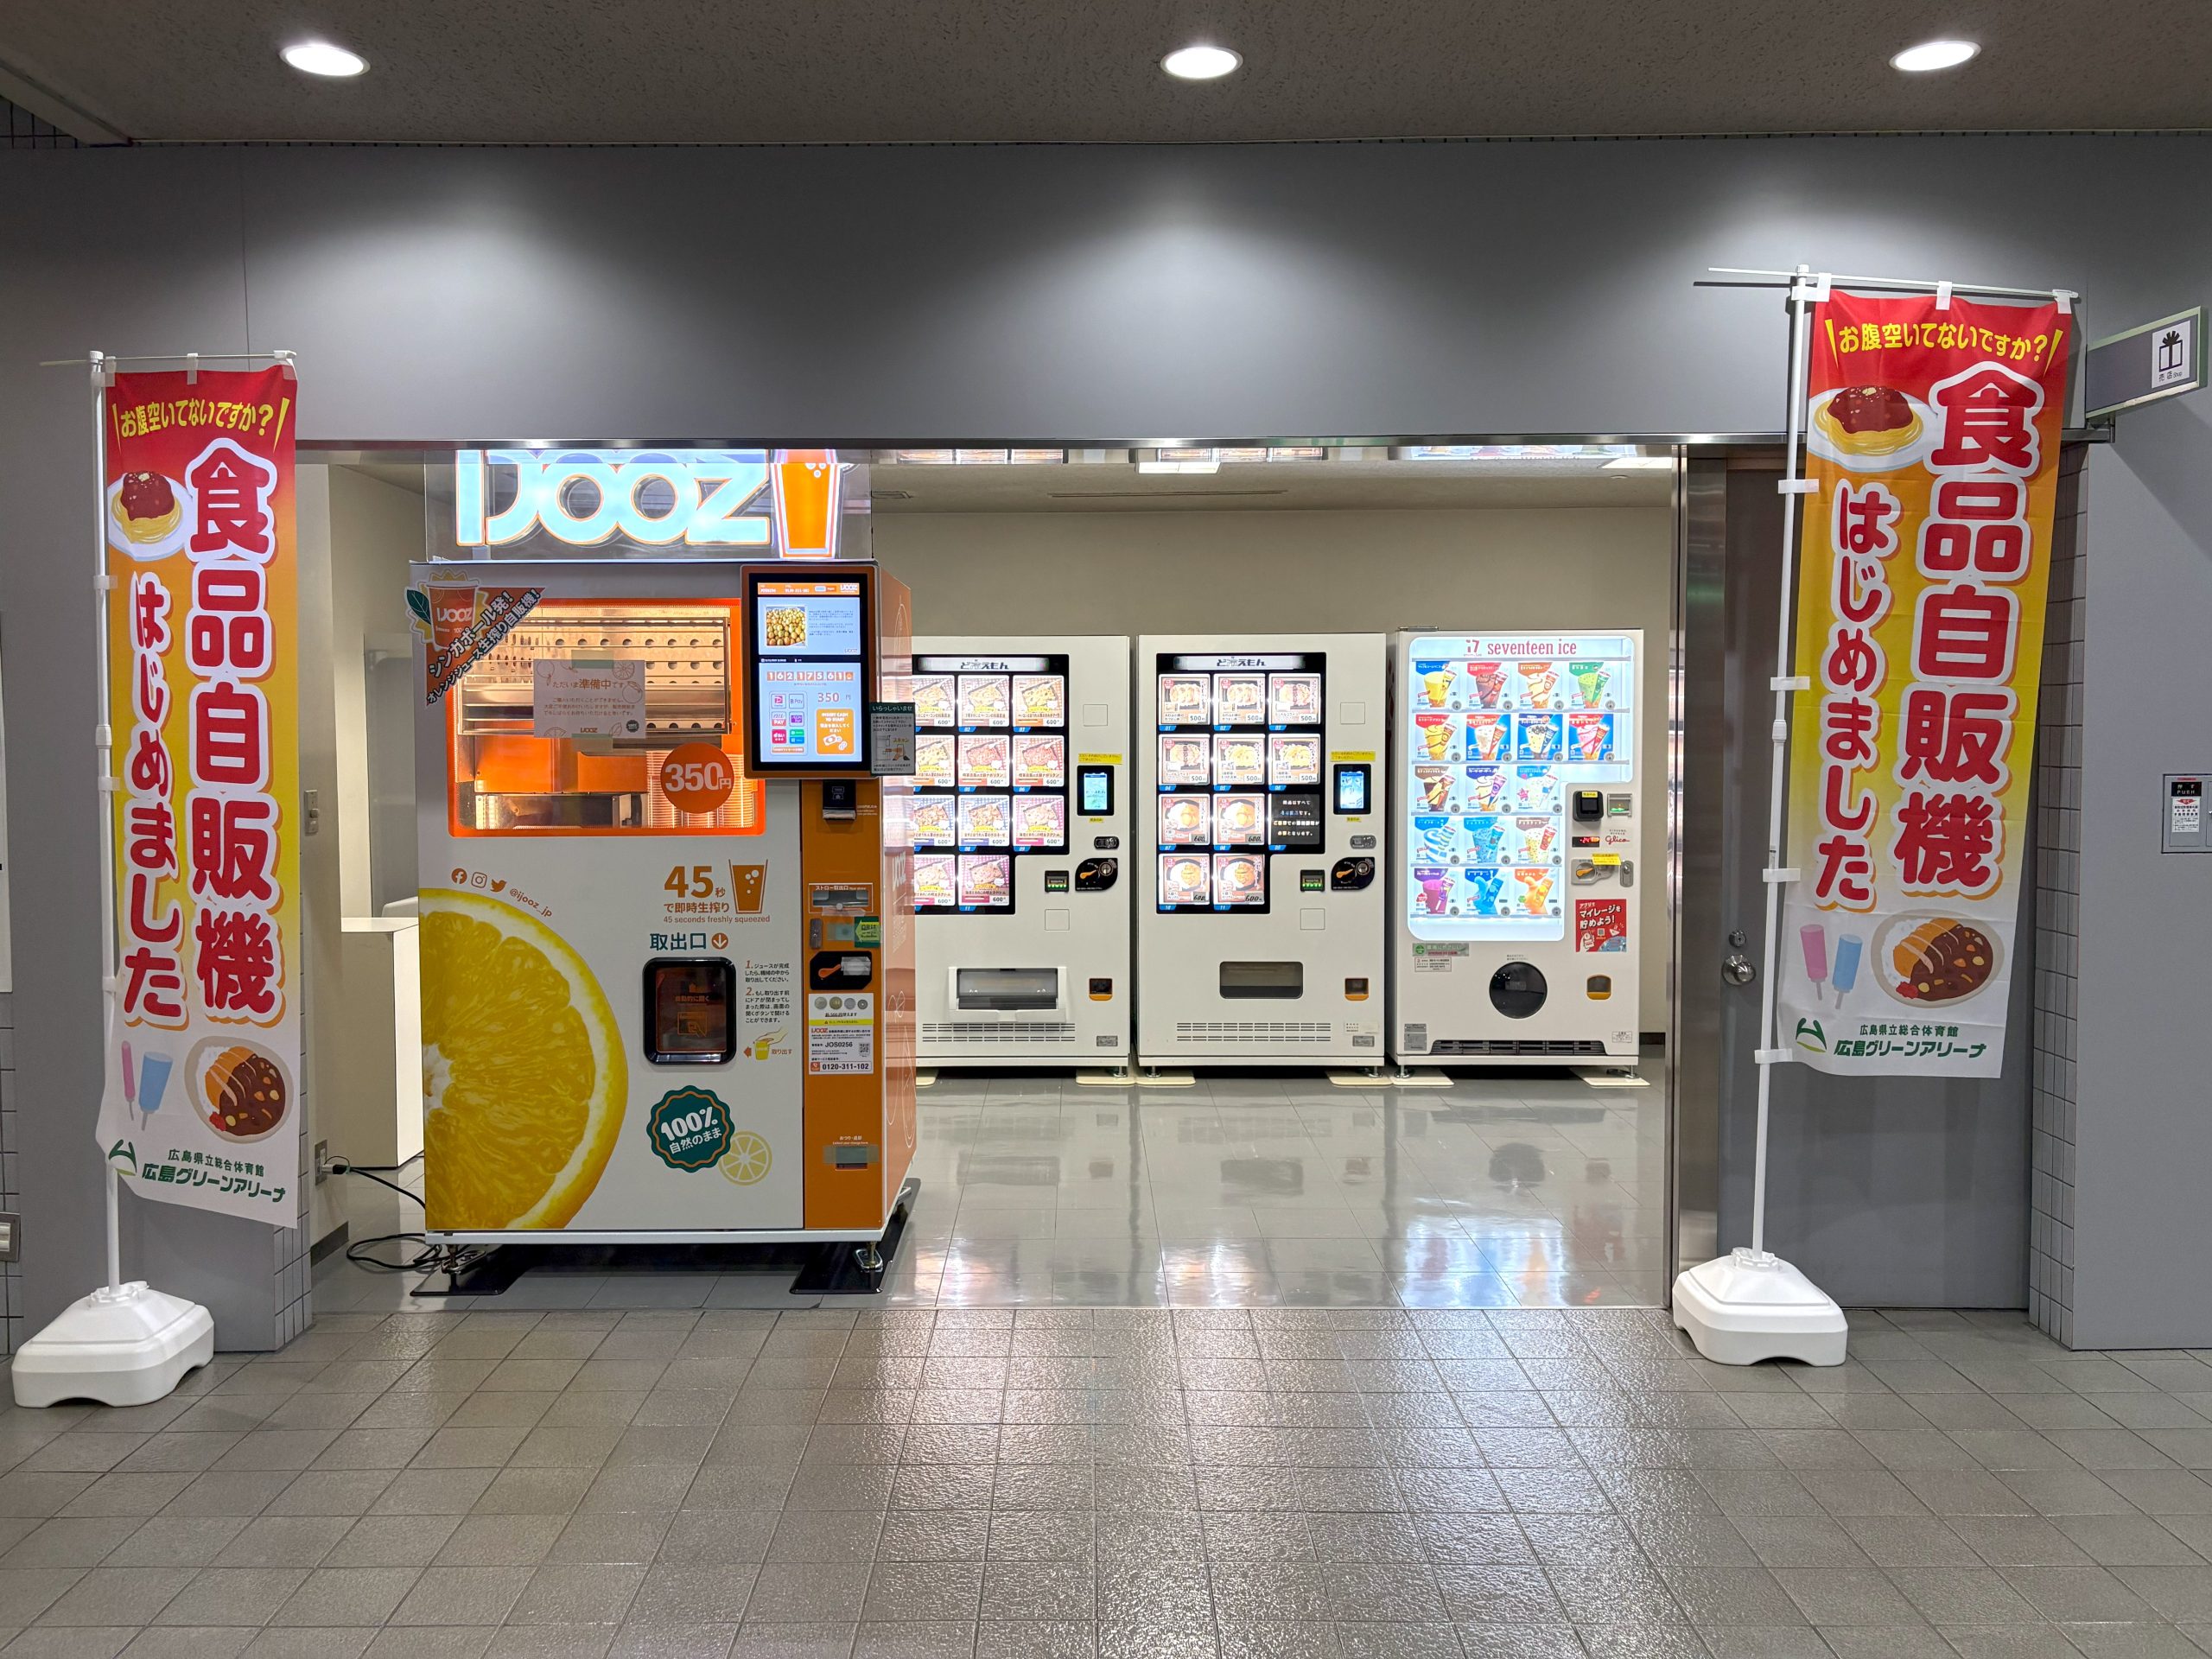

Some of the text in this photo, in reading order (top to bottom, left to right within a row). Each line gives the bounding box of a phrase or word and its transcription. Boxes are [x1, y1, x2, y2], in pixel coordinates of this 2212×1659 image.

[436, 607, 473, 623] IJOOZ
[1891, 363, 2043, 892] 食品自販機
[1487, 640, 1554, 655] seventeen
[1558, 639, 1577, 654] ice
[817, 693, 840, 702] 350
[1814, 480, 1898, 903] はじめました
[187, 439, 278, 1016] 食品自販機
[664, 762, 732, 792] 350円
[122, 573, 182, 1020] はじめました
[1605, 836, 1630, 845] Glico
[664, 866, 726, 899] 45秒
[510, 888, 552, 917] @ijooz_jp
[664, 902, 730, 913] で即時生搾り
[1580, 905, 1621, 918] マイレージを
[708, 915, 733, 924] freshly
[734, 915, 770, 925] squeezed
[650, 932, 707, 951] 取出口
[1859, 1024, 1959, 1037] 広島県立総合体育館
[1834, 1039, 1987, 1058] 広島グリーンアリーナ
[660, 1106, 718, 1141] 100%
[669, 1127, 722, 1154] 自然のまま
[168, 1149, 265, 1177] 広島県立総合体育館
[142, 1162, 287, 1203] 広島グリーンアリーナ
